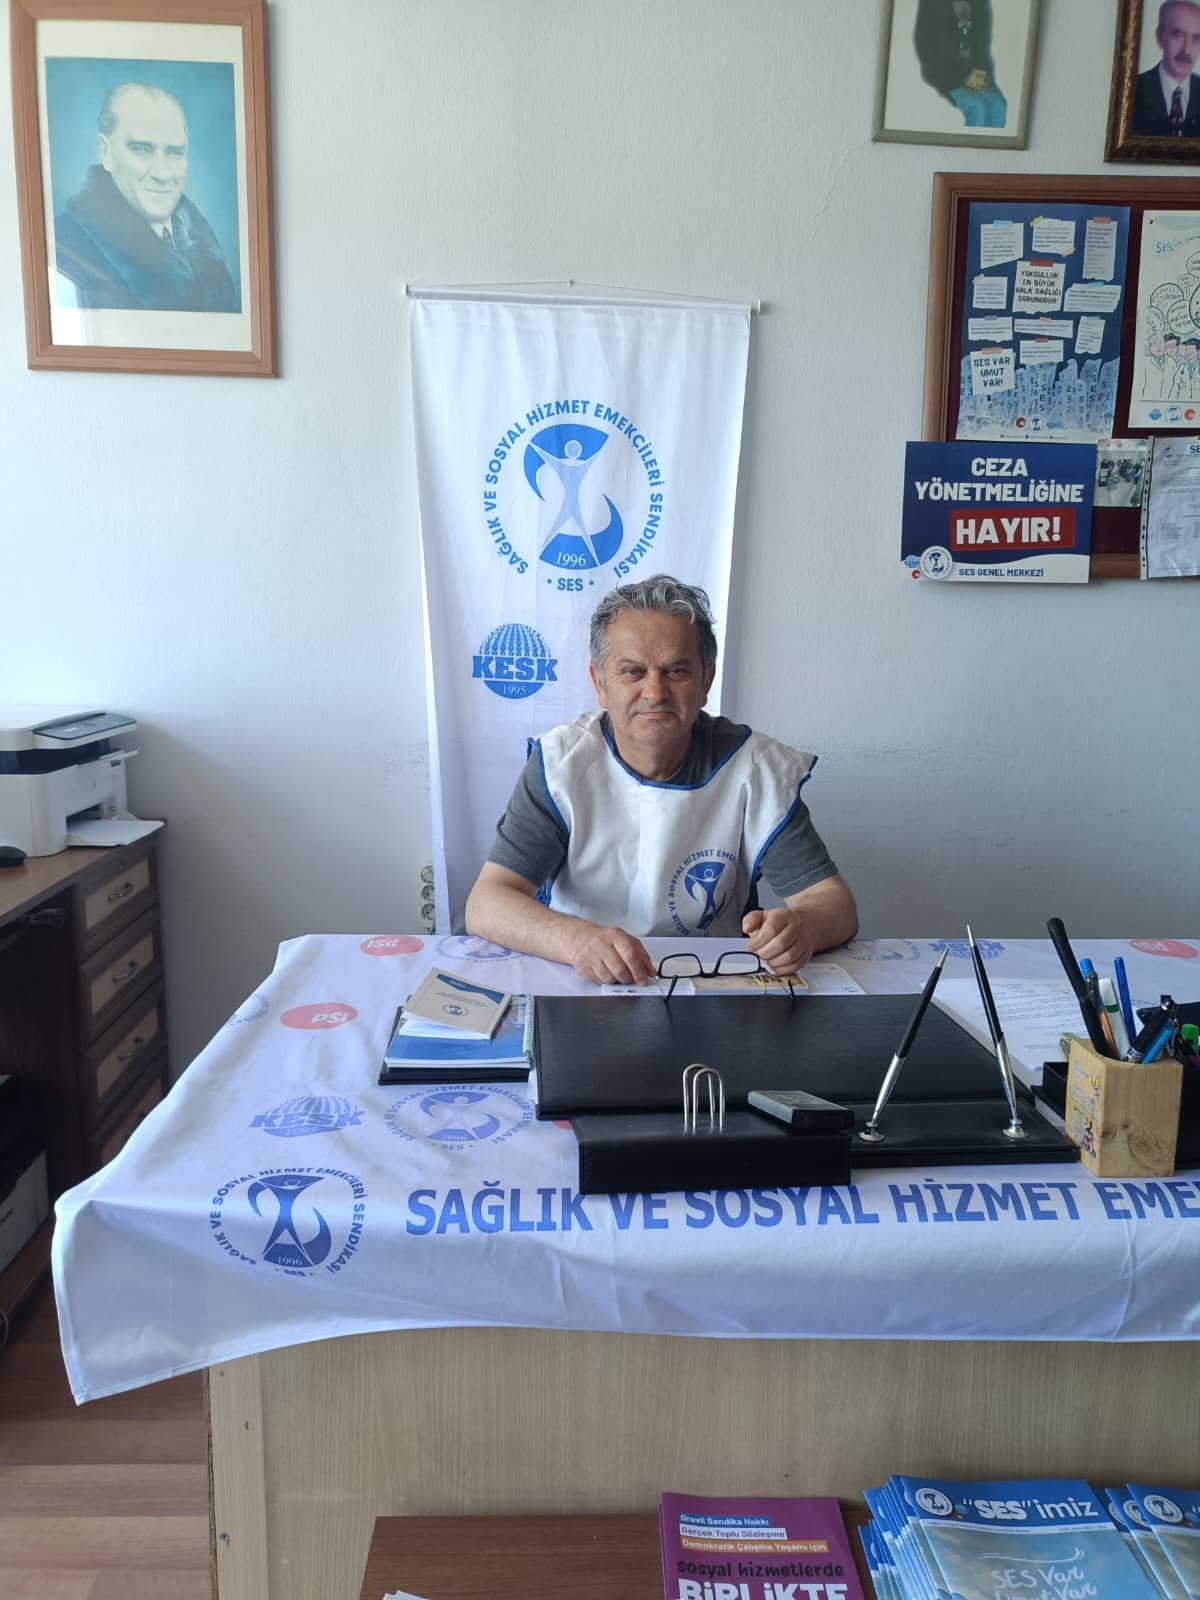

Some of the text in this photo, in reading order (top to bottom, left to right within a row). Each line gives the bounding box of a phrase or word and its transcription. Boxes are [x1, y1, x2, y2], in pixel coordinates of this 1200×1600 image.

[973, 357, 1010, 367] SES VAR
[980, 367, 1004, 377] UMUT
[983, 378, 1003, 388] VAR!
[971, 458, 1029, 477] CEZA
[484, 399, 666, 579] SAĞLIK VE SOSYAL HİZMET EMEKÇİLERİ SENDİKASI
[914, 477, 1085, 503] YÖNETMELİĞİNE
[955, 516, 1062, 545] HAYIR!
[555, 551, 587, 567] 1996
[958, 567, 1044, 577] SES GENEL MERKEZİ
[557, 577, 584, 592] SES
[472, 655, 559, 682] KESK
[502, 684, 527, 696] 1995
[668, 866, 685, 898] SOSYAL
[683, 849, 714, 867] HİZMET
[248, 1111, 367, 1128] KESK
[259, 1167, 314, 1176] HİZMET
[212, 1173, 257, 1206] SOSYAL
[406, 1178, 1200, 1235] SAĞLIK VE SOSYAL HİZMET EME
[210, 1211, 222, 1229] VE
[326, 1203, 366, 1274] SENDİKASI
[214, 1231, 257, 1266] SAĞLIK
[680, 1513, 769, 1526] Grevli Sendika Hakkı
[681, 1526, 785, 1539] Gerçek Toplu Sözleşme
[682, 1539, 826, 1553] Demokratik Çalışma Yaşamı için
[677, 1560, 845, 1579] sosyal hizmetlerde
[990, 1568, 1038, 1589] SES
